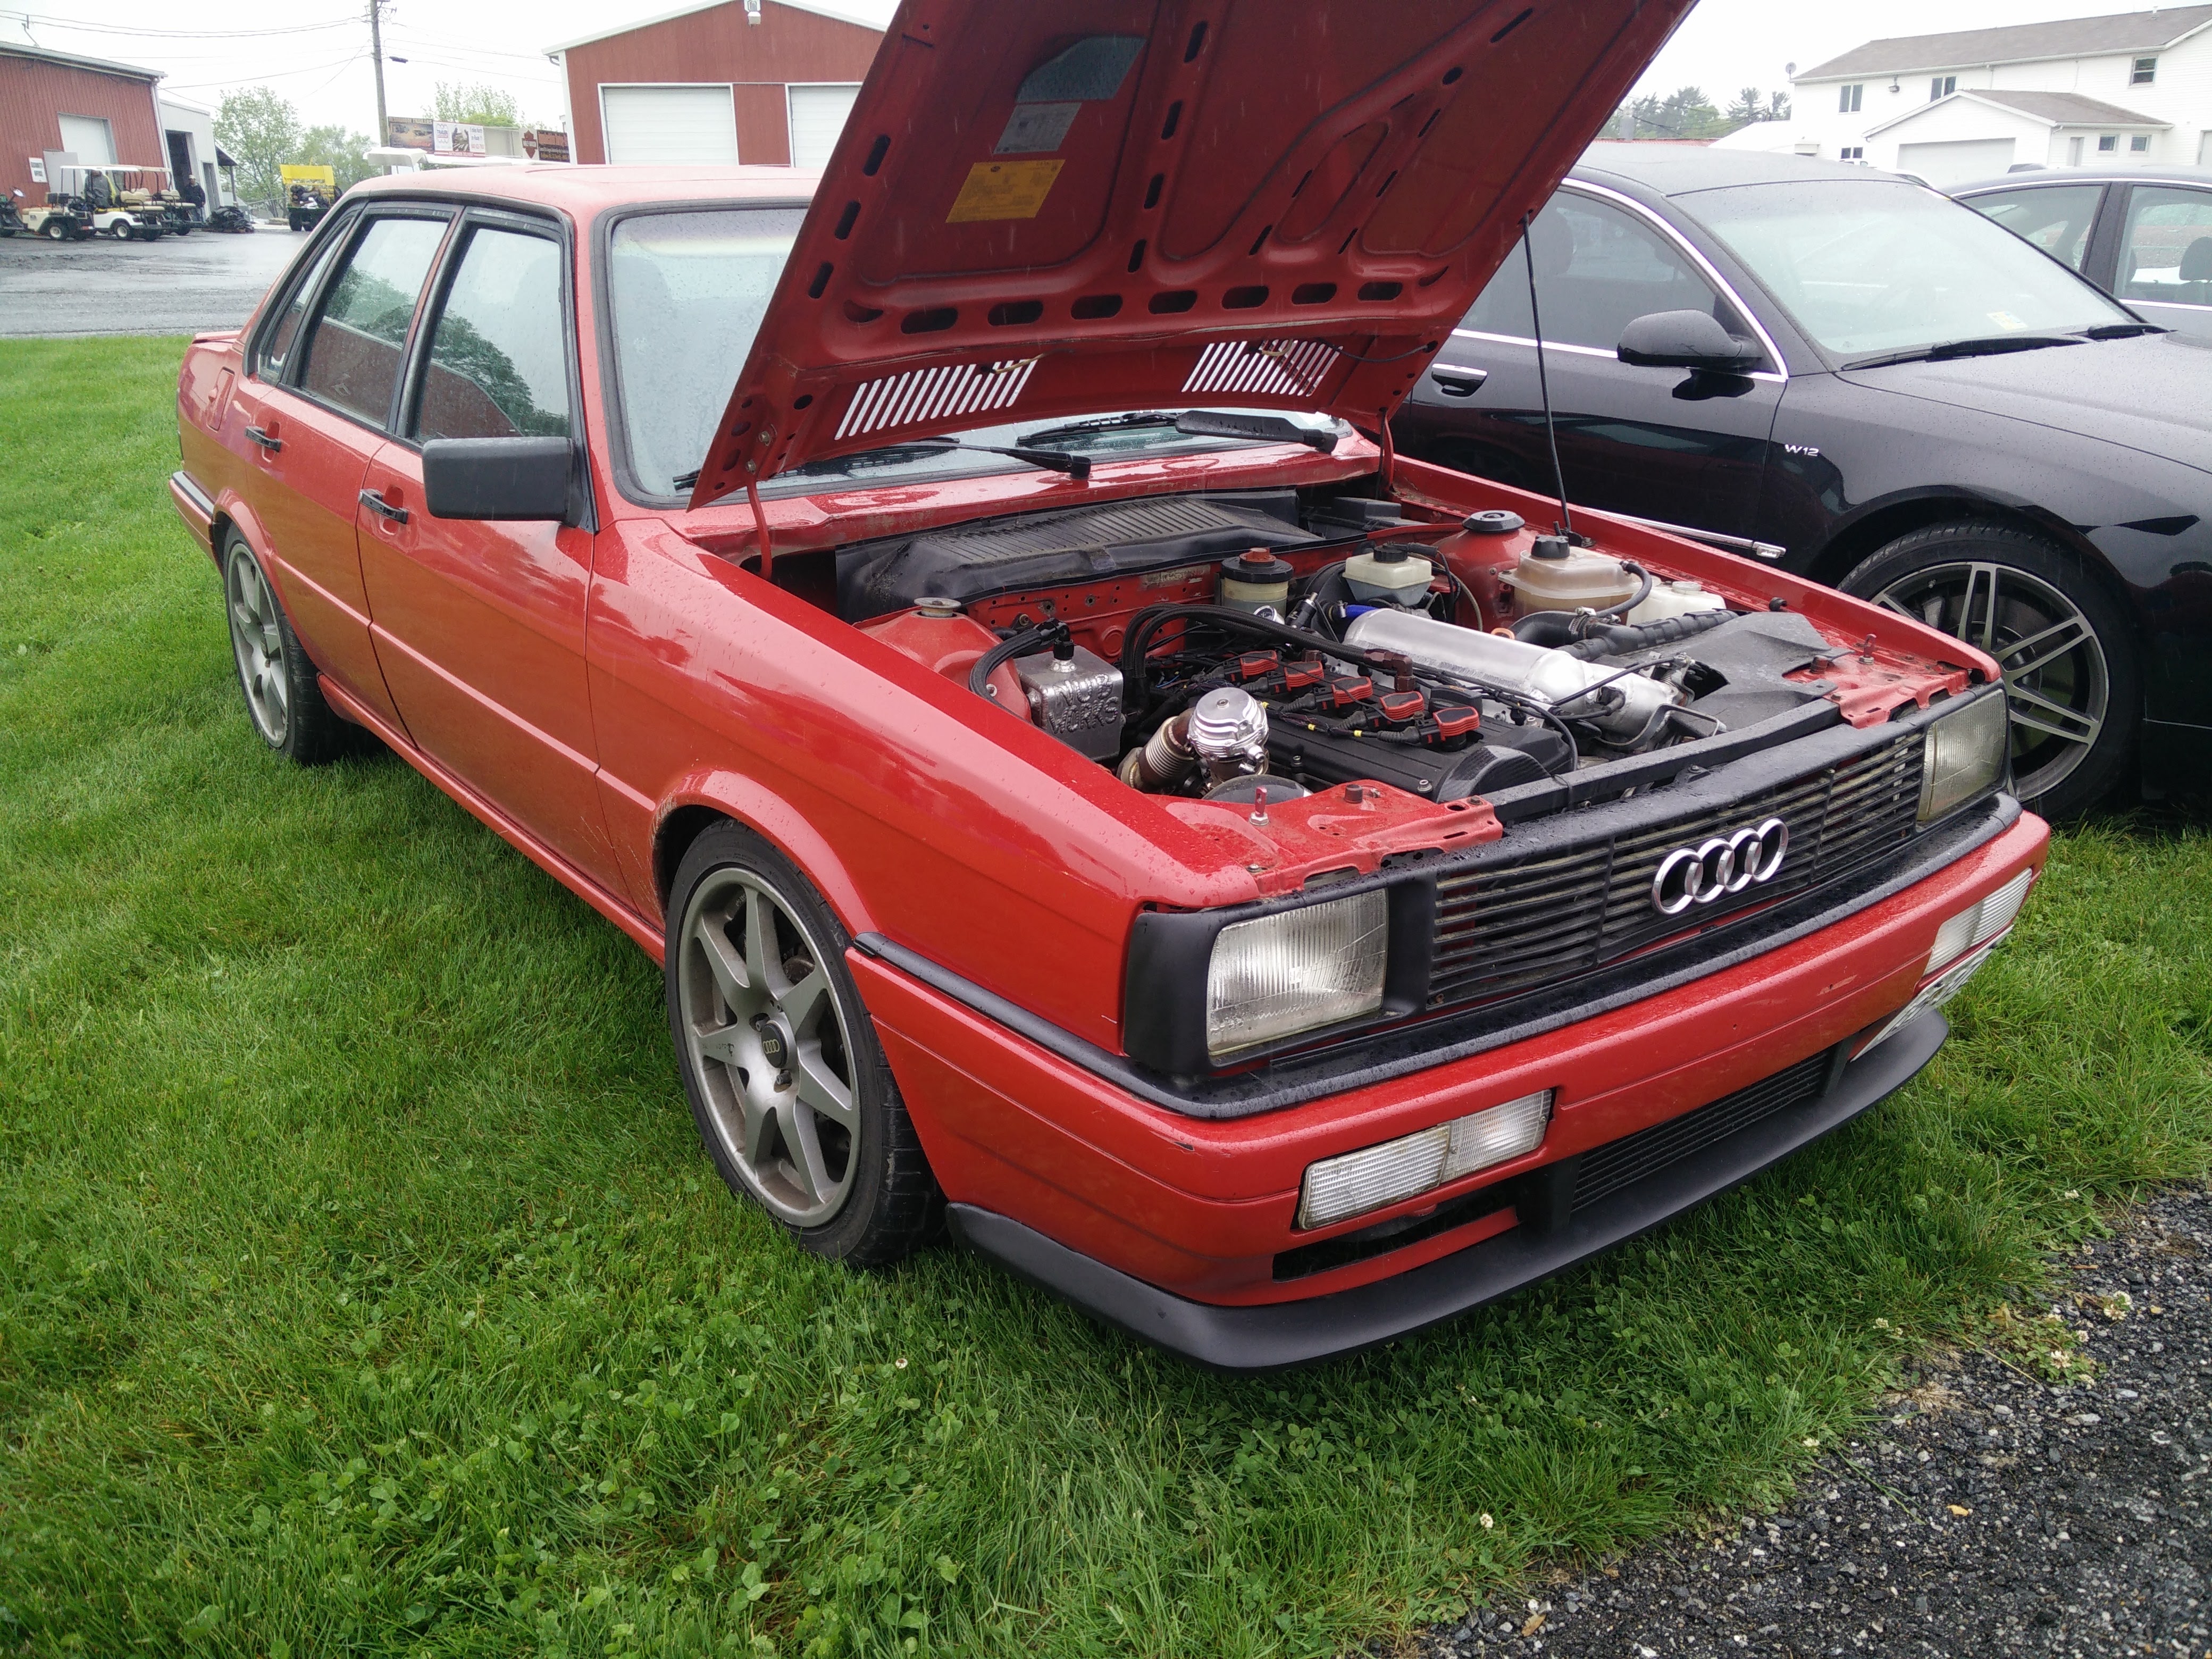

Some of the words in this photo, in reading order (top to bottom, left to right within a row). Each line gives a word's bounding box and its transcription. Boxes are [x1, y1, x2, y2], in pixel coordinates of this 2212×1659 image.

[1784, 444, 1819, 456] W12
[1053, 673, 1113, 706] NUB
[1048, 696, 1119, 734] WORKS
